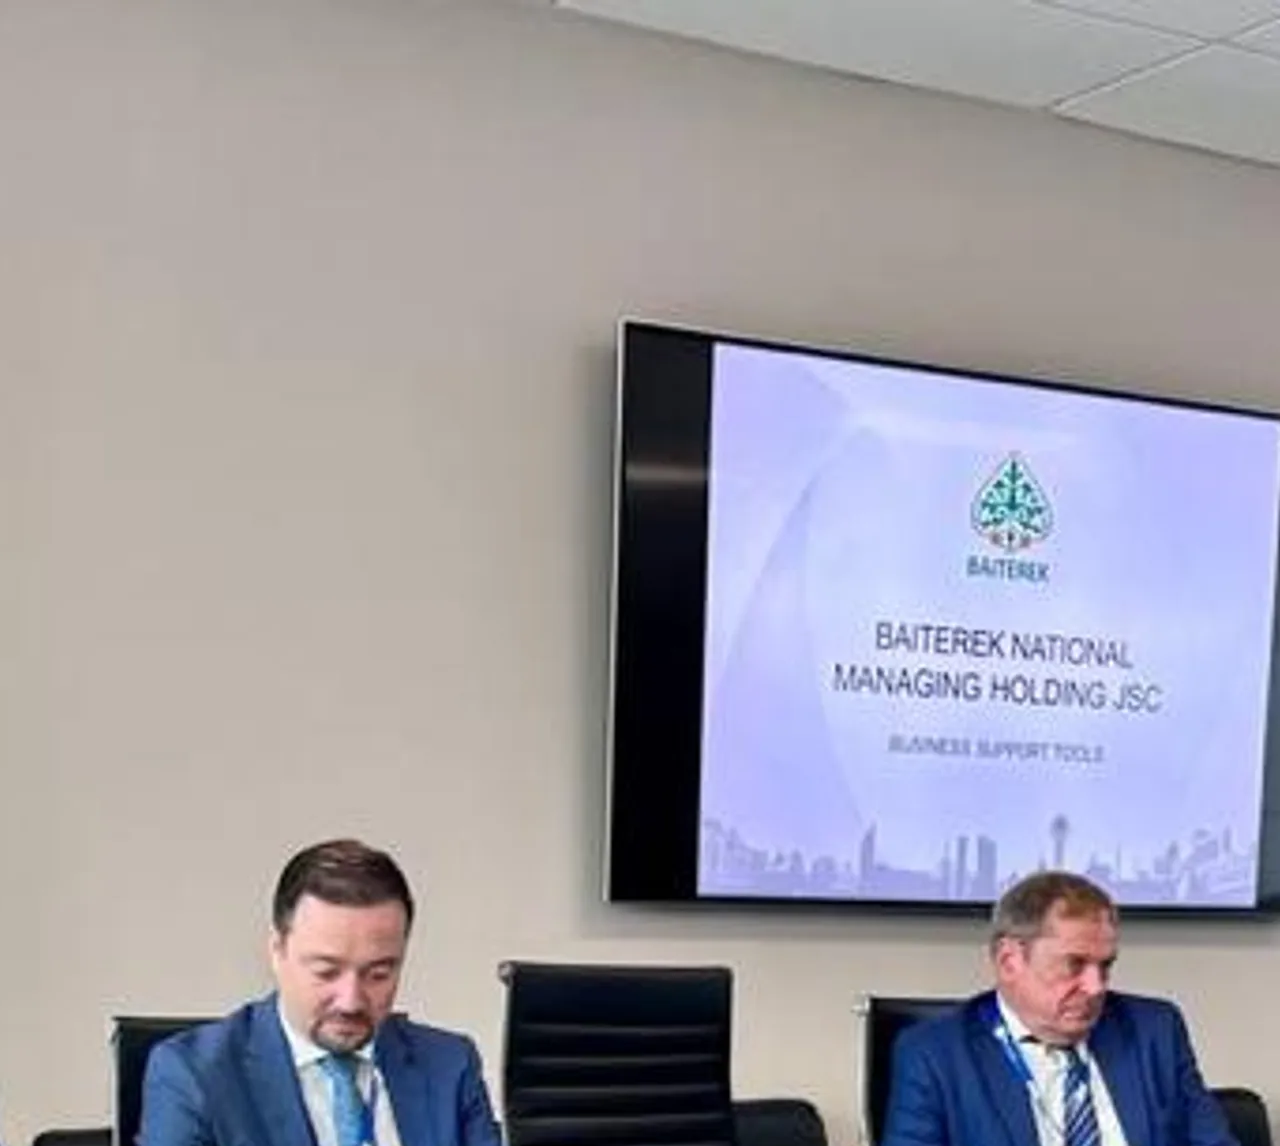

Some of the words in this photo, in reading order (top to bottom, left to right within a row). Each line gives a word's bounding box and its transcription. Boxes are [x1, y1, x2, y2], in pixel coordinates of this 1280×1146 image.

[966, 555, 1051, 583] BAITEREK
[875, 621, 1006, 659] BAITEREK
[1010, 632, 1133, 669] NATIONAL
[833, 662, 982, 701] MANAGING
[988, 673, 1107, 712] HOLDING
[1111, 682, 1165, 714] JSC
[887, 733, 972, 757] BUSINESS
[975, 736, 1049, 761] SUPPORT
